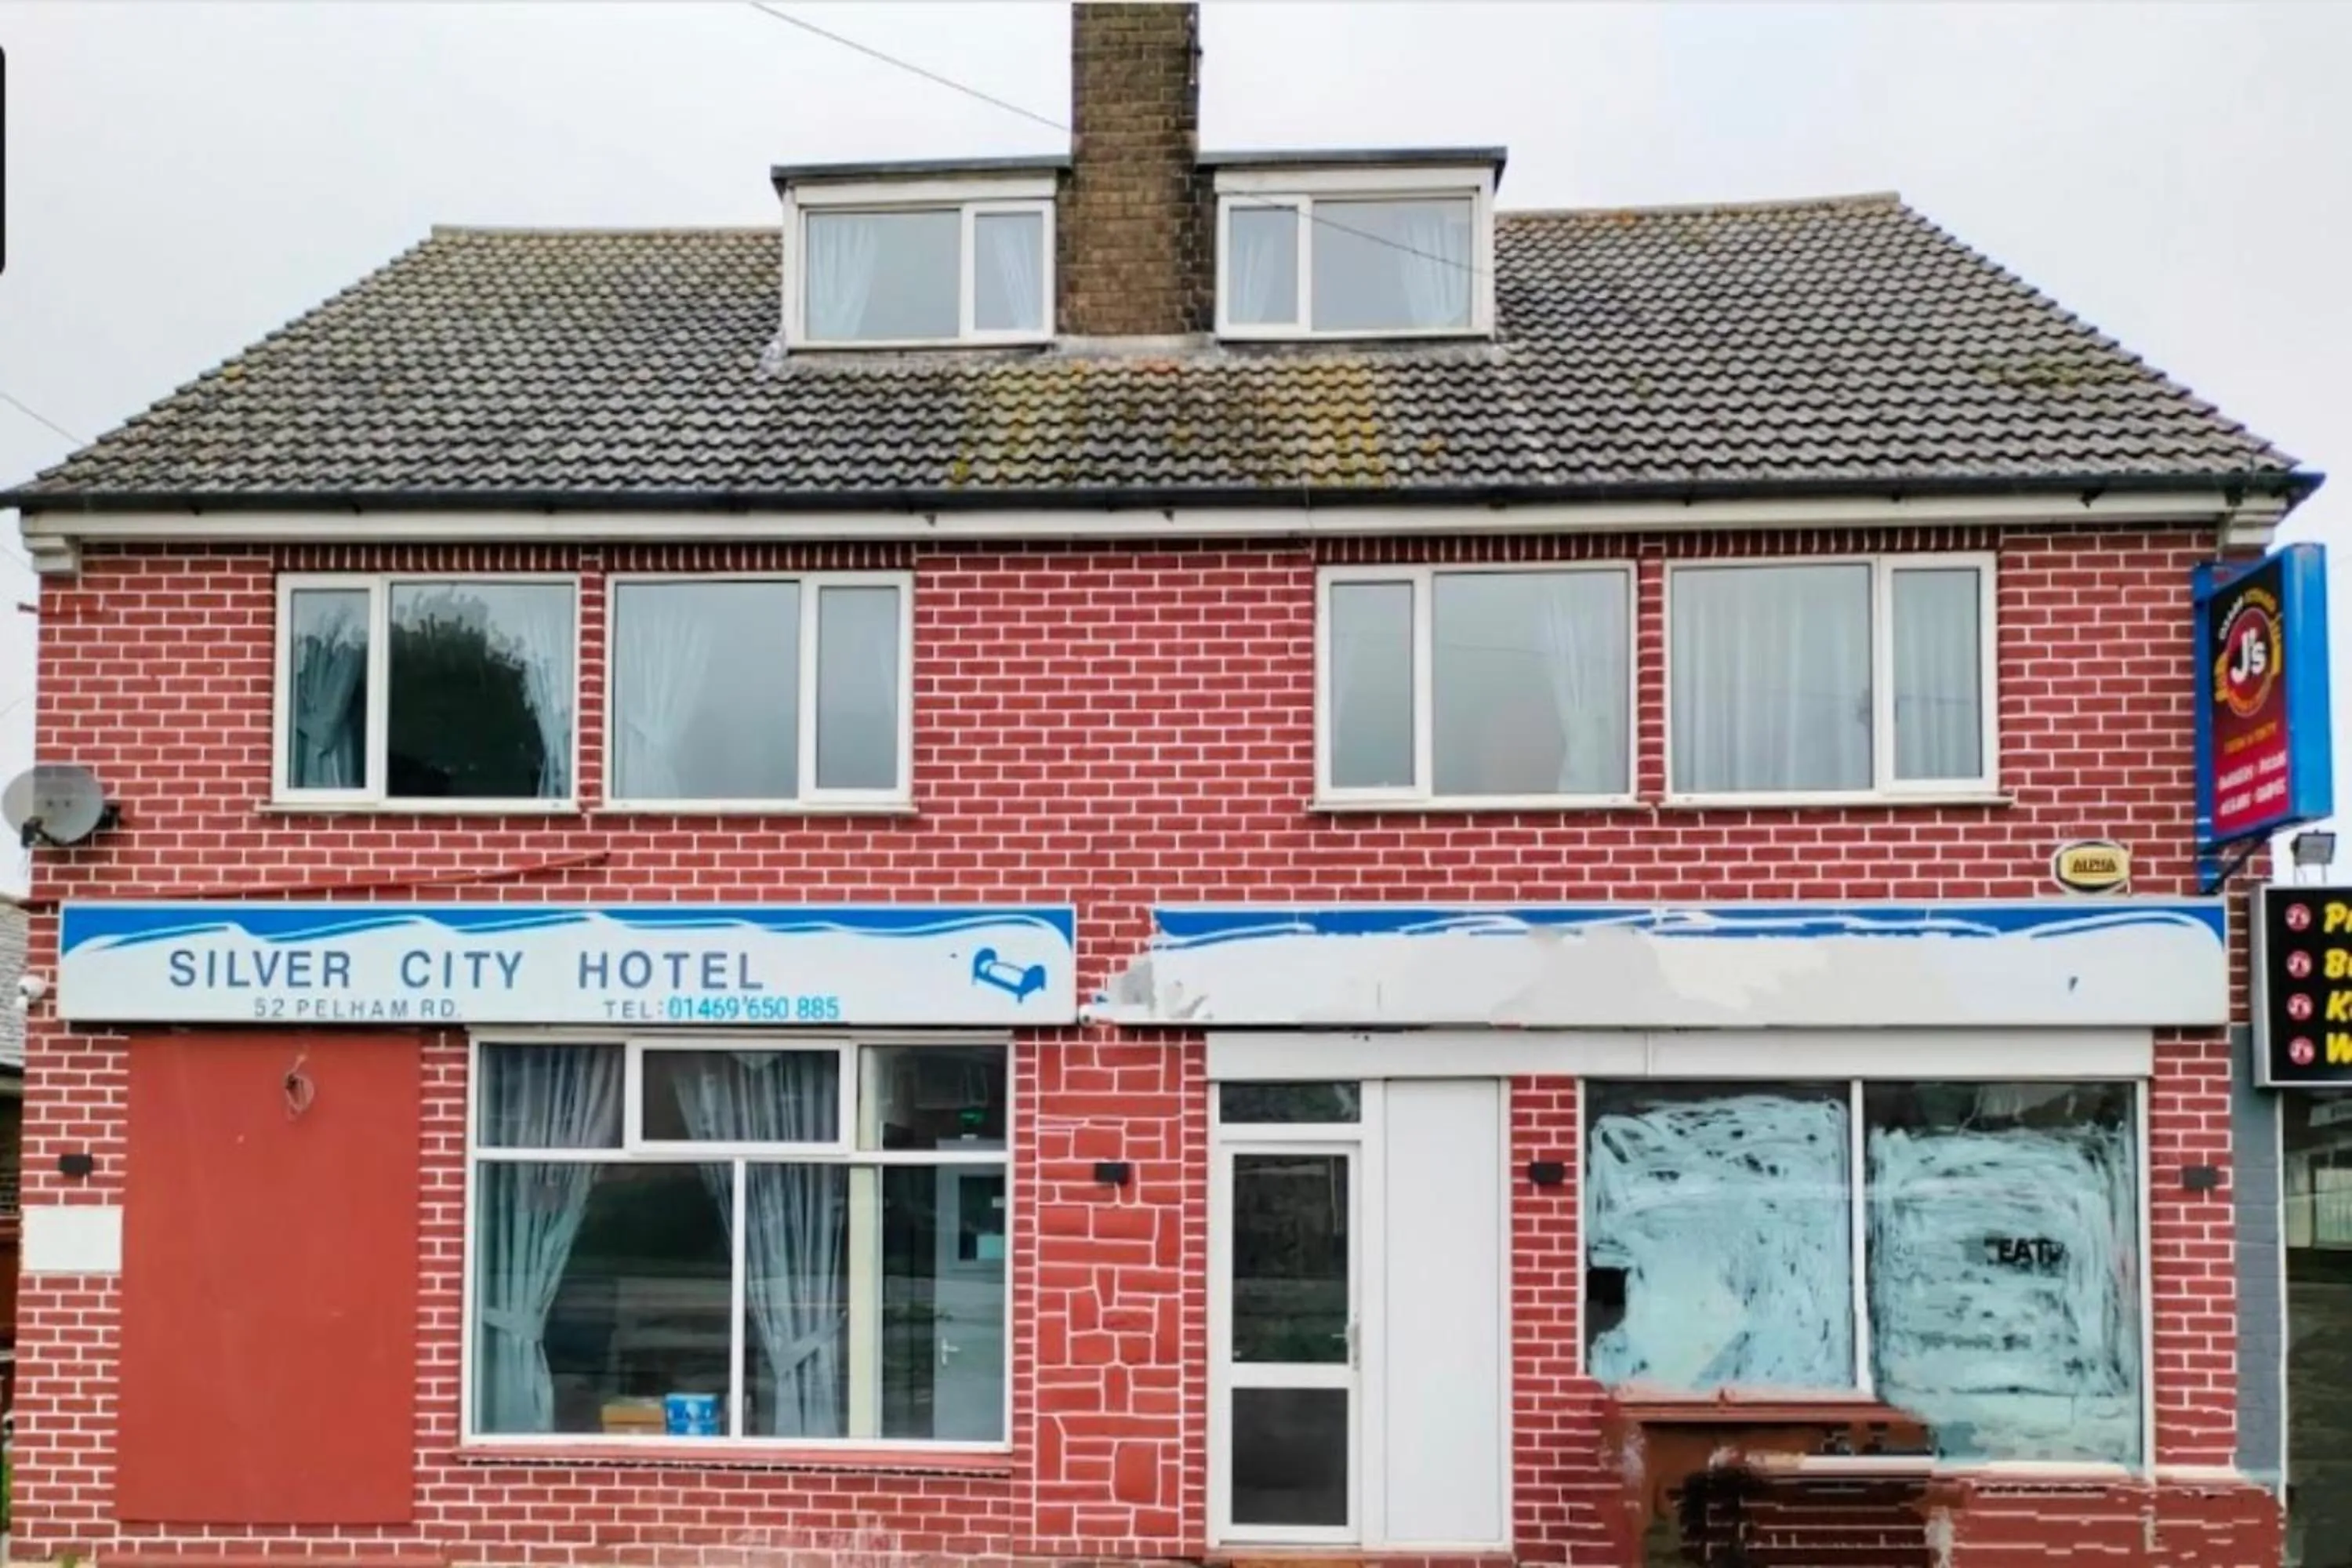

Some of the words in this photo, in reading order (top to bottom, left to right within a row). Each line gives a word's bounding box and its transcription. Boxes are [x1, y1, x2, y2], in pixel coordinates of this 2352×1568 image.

[2230, 627, 2268, 684] J's
[169, 949, 352, 990] SILVER
[400, 949, 524, 991] CITY
[577, 950, 764, 993] HOTEL
[253, 998, 285, 1018] 52
[296, 998, 409, 1018] PELHAM
[797, 995, 840, 1020] 885
